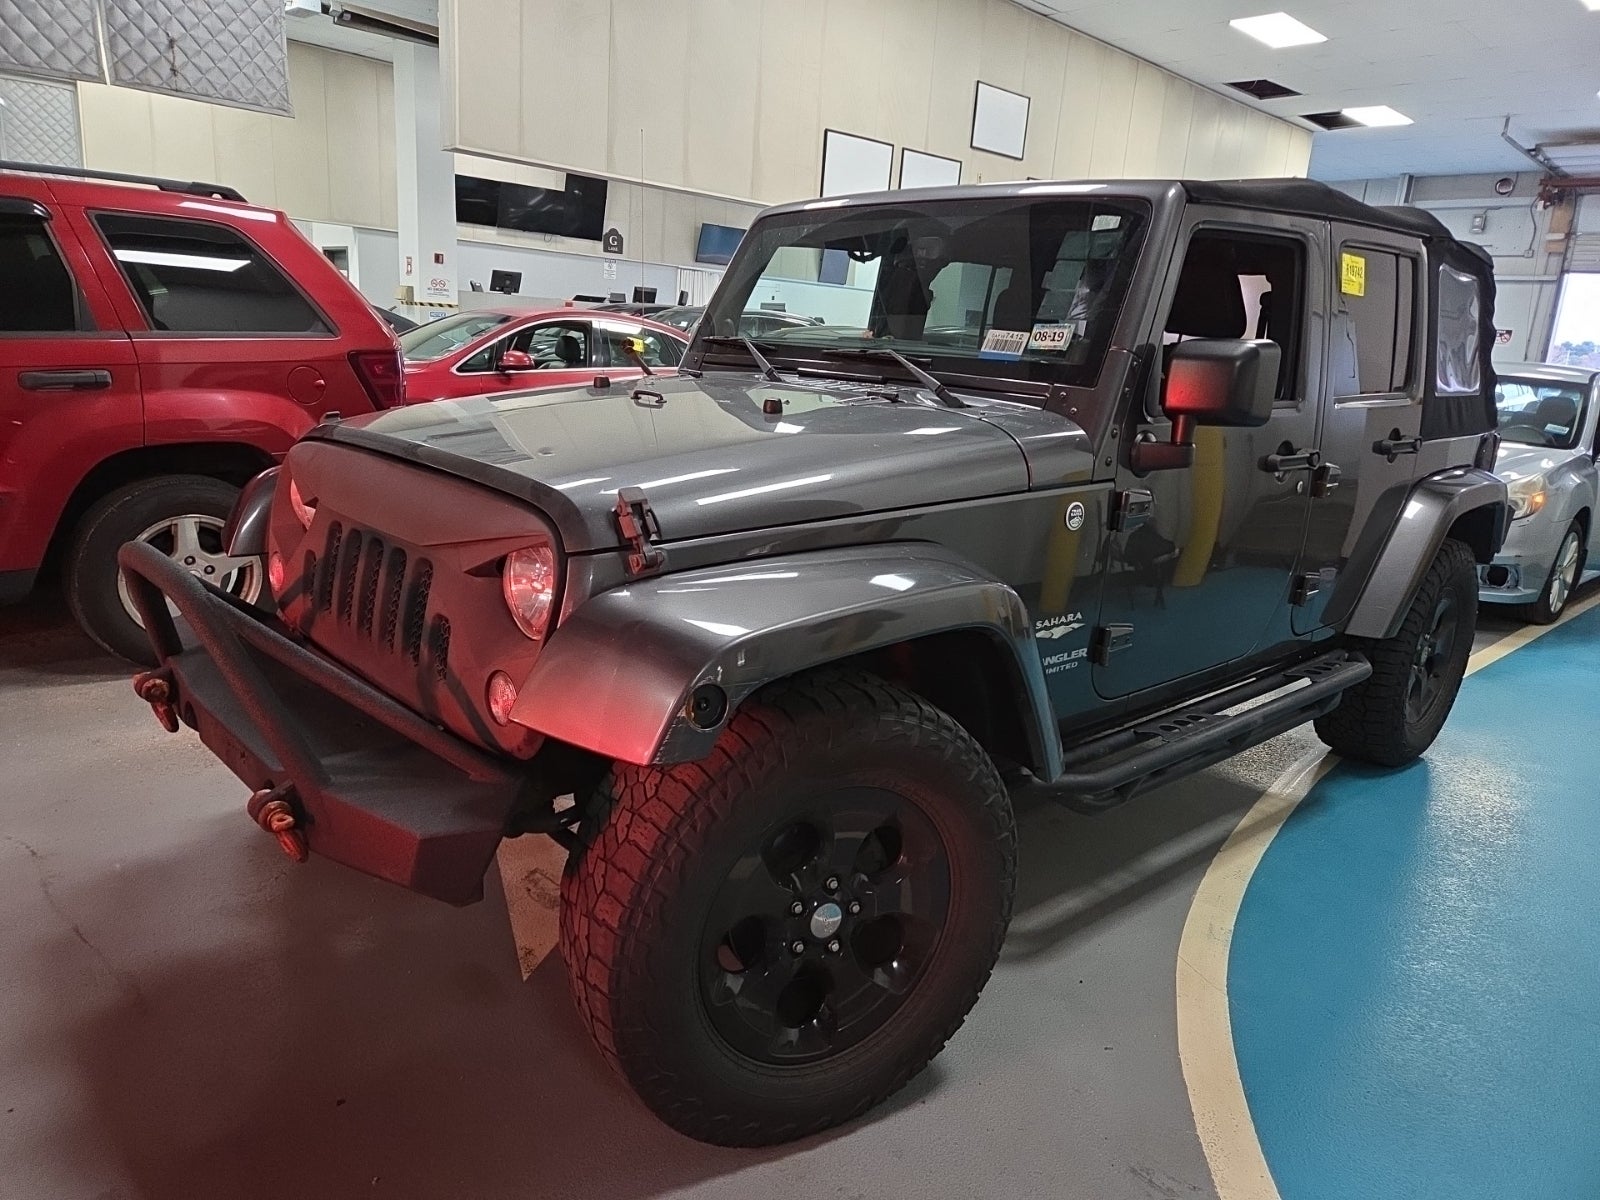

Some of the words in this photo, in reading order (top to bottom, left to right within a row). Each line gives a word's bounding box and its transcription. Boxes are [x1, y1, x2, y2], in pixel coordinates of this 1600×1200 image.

[609, 235, 618, 246] G
[1034, 331, 1065, 342] 08-19
[1035, 611, 1083, 630] SAHARA
